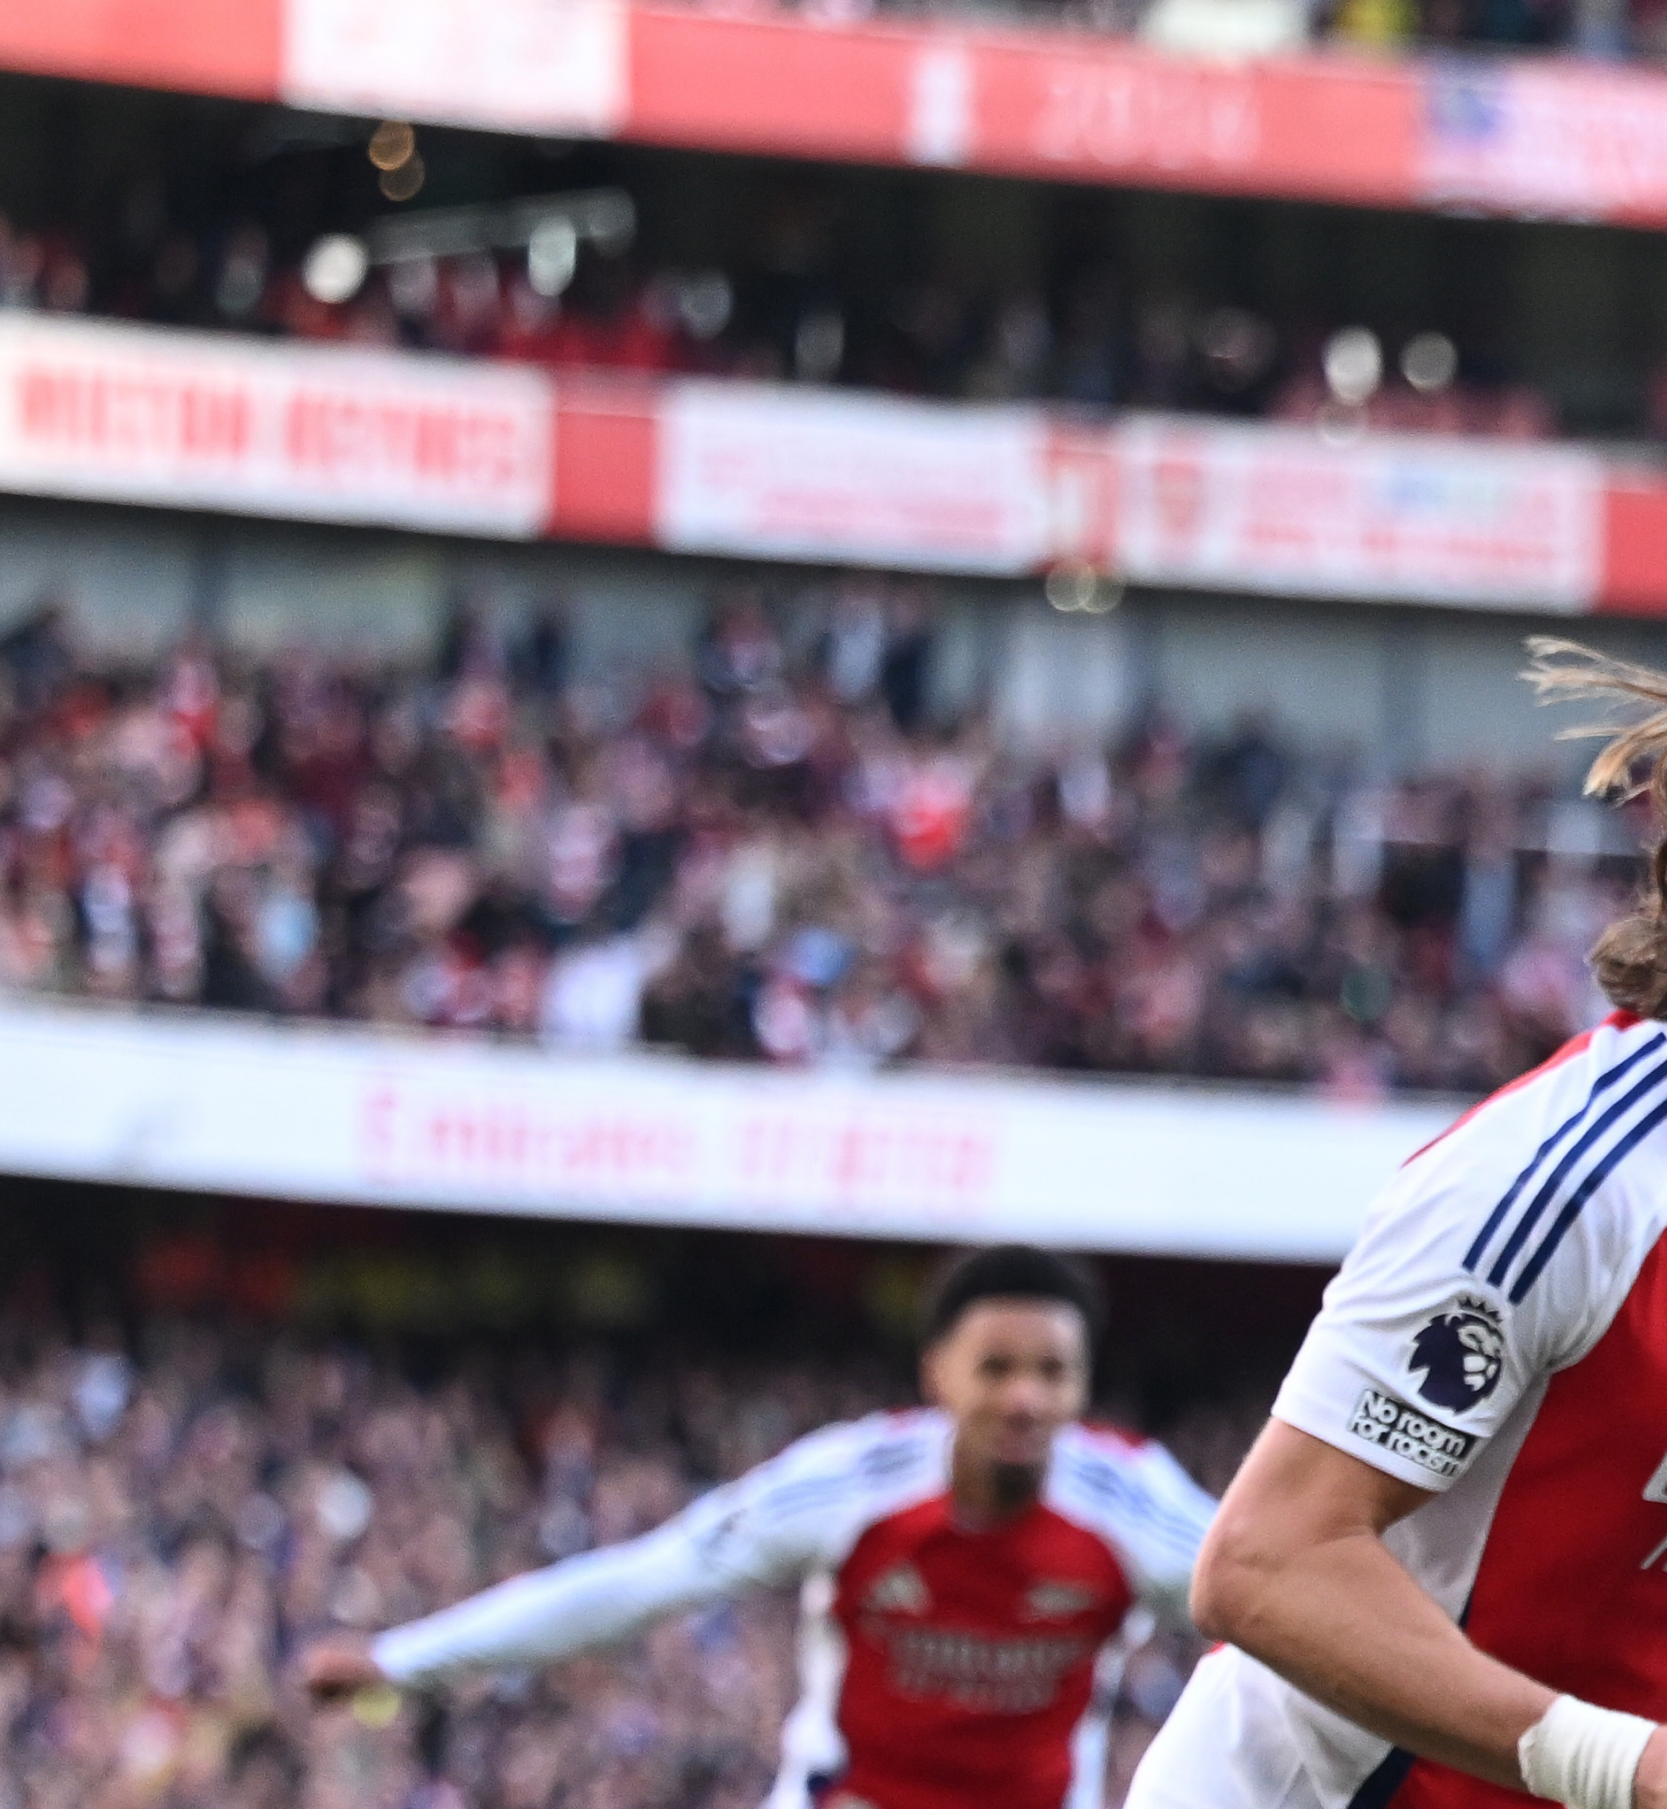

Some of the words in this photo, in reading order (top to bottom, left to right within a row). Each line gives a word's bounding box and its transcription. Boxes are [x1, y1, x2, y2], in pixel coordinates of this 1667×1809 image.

[1351, 1410, 1391, 1441] for
[1386, 1430, 1461, 1477] racism
[1361, 1389, 1399, 1424] No
[1396, 1411, 1467, 1457] room
